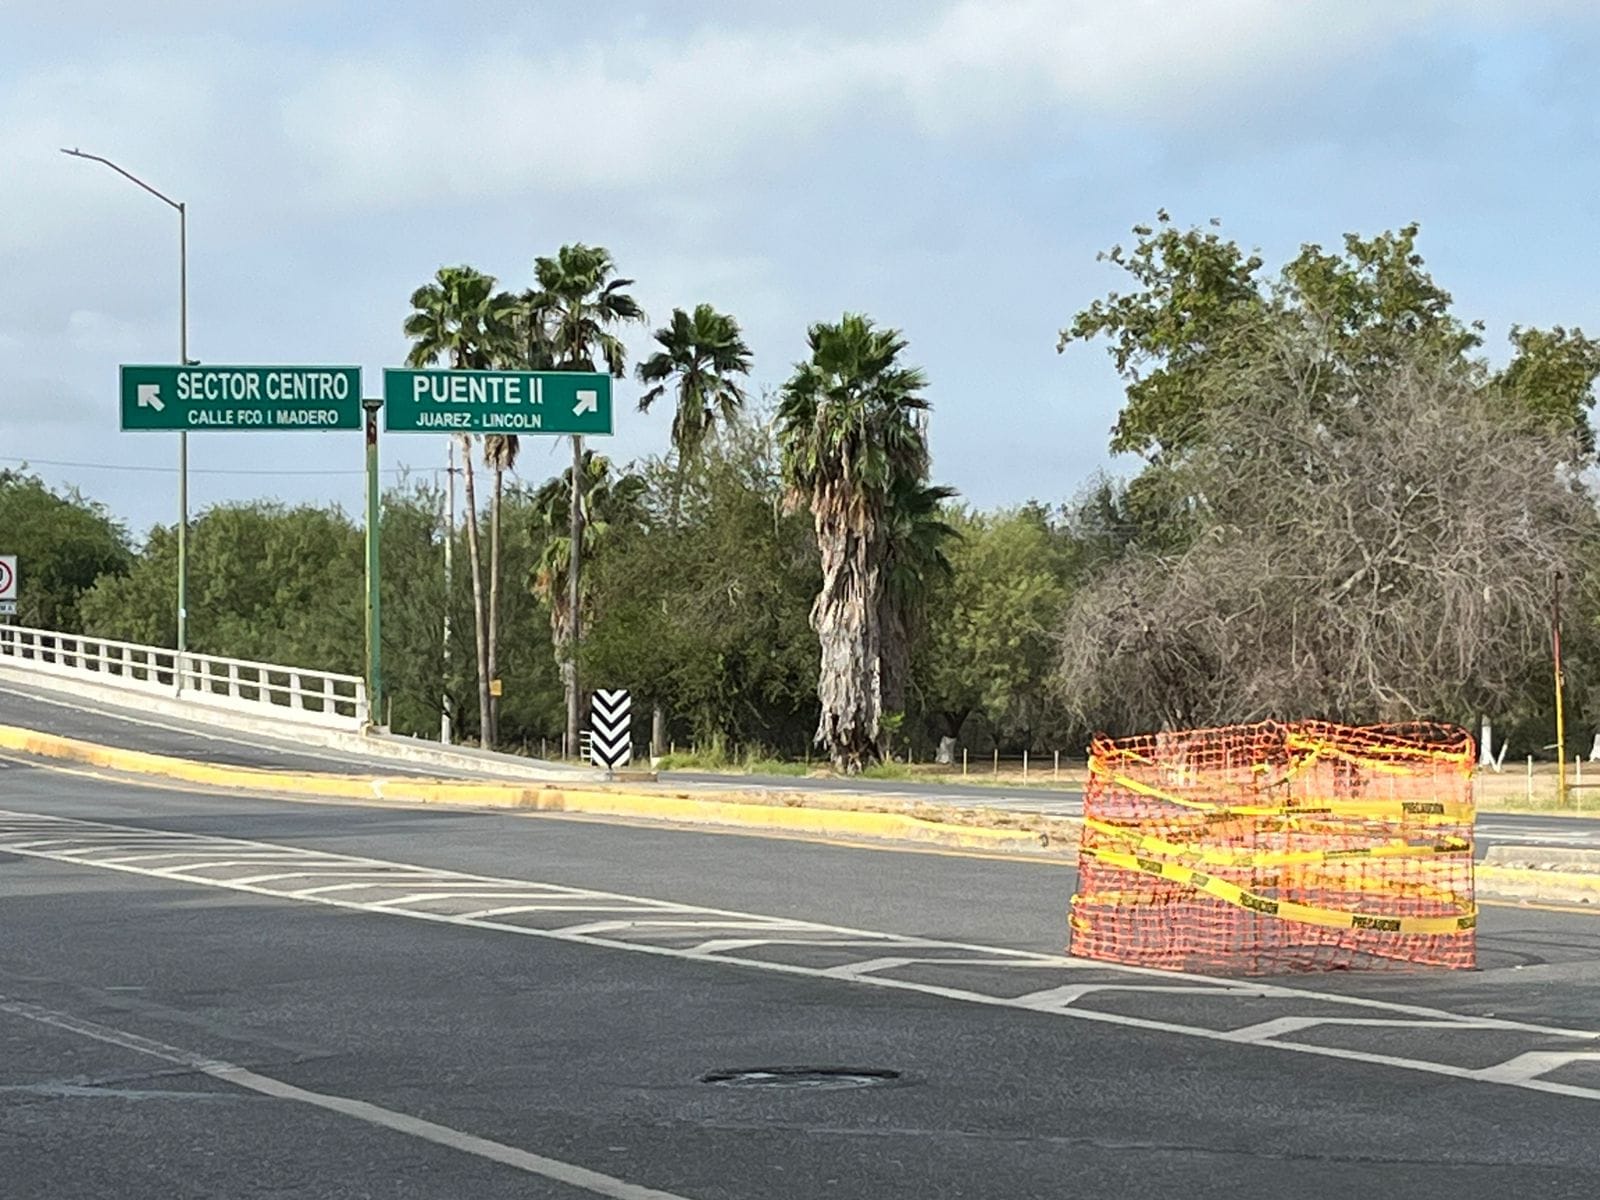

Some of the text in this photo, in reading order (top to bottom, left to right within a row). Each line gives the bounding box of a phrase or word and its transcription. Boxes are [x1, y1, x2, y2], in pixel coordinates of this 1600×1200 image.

[177, 372, 349, 400] SECTOR CENTRO
[413, 376, 543, 404] PUENTE II
[188, 409, 234, 425] CALLE
[276, 409, 339, 425] MADERO
[416, 413, 471, 427] JUAREZ
[482, 413, 541, 428] LINCOLN
